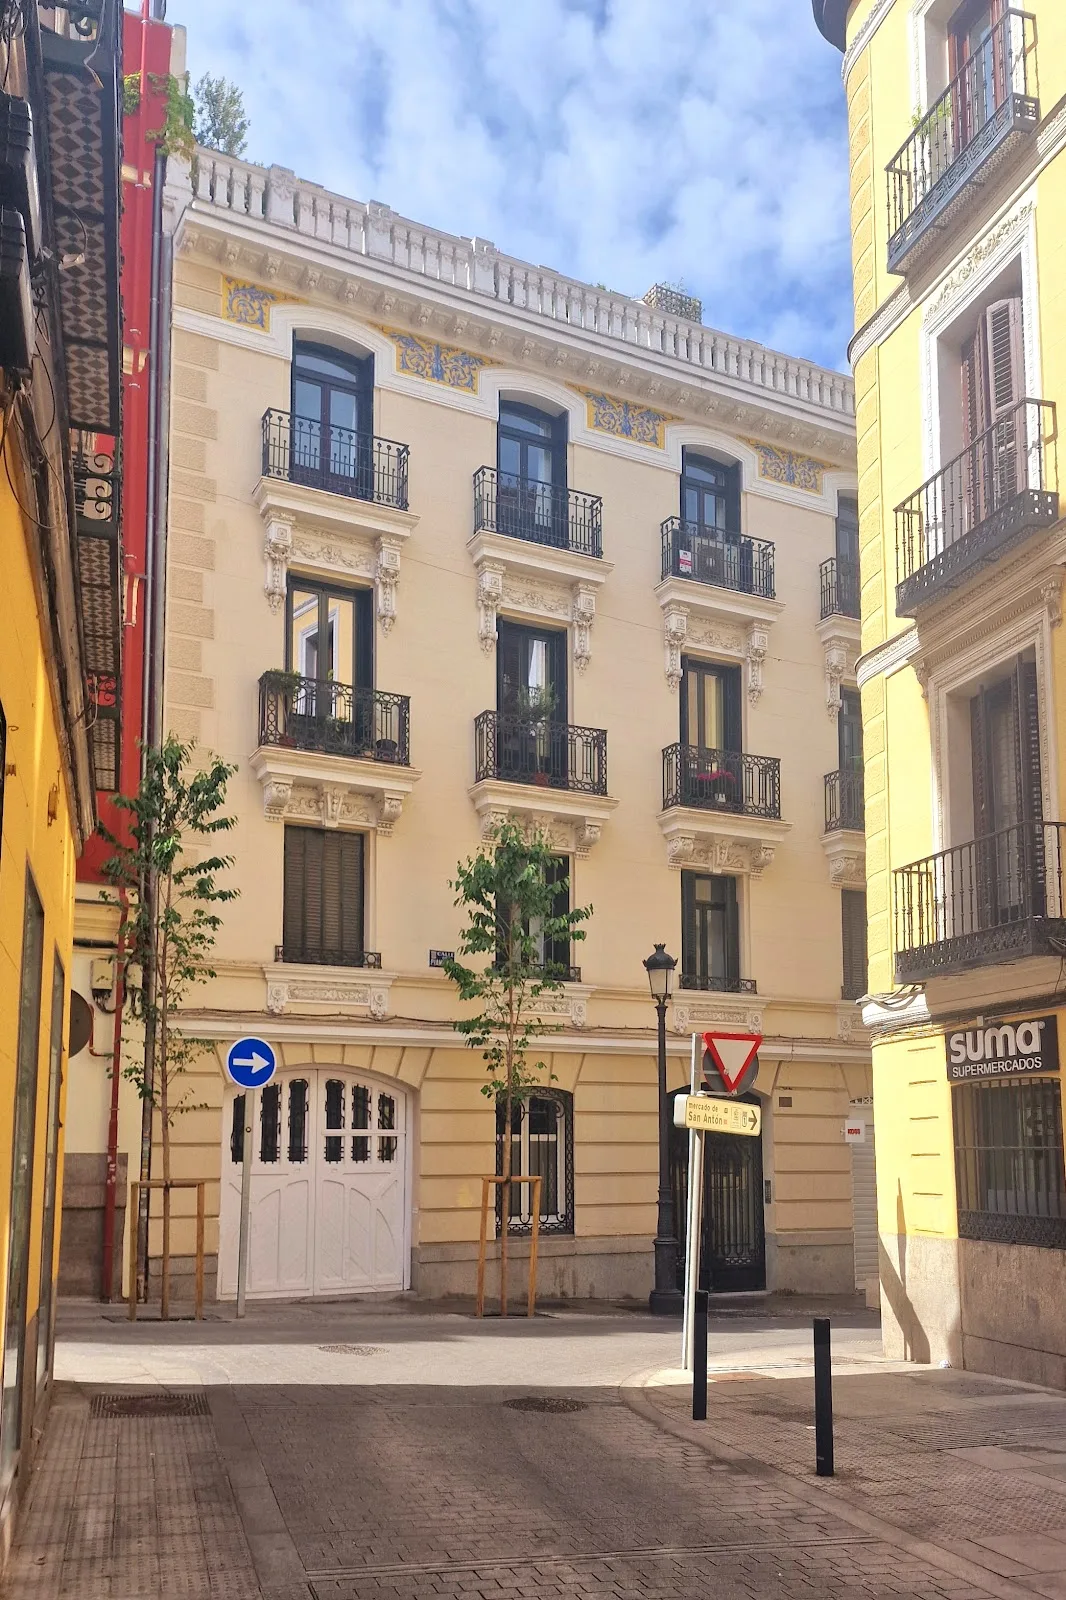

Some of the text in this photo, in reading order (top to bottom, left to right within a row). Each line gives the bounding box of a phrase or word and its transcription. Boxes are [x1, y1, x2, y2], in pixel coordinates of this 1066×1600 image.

[950, 1022, 1042, 1064] suma
[952, 1056, 1042, 1077] SUPERMERCADOS
[688, 1102, 710, 1112] mercado
[688, 1111, 700, 1122] San
[703, 1113, 722, 1125] Antón
